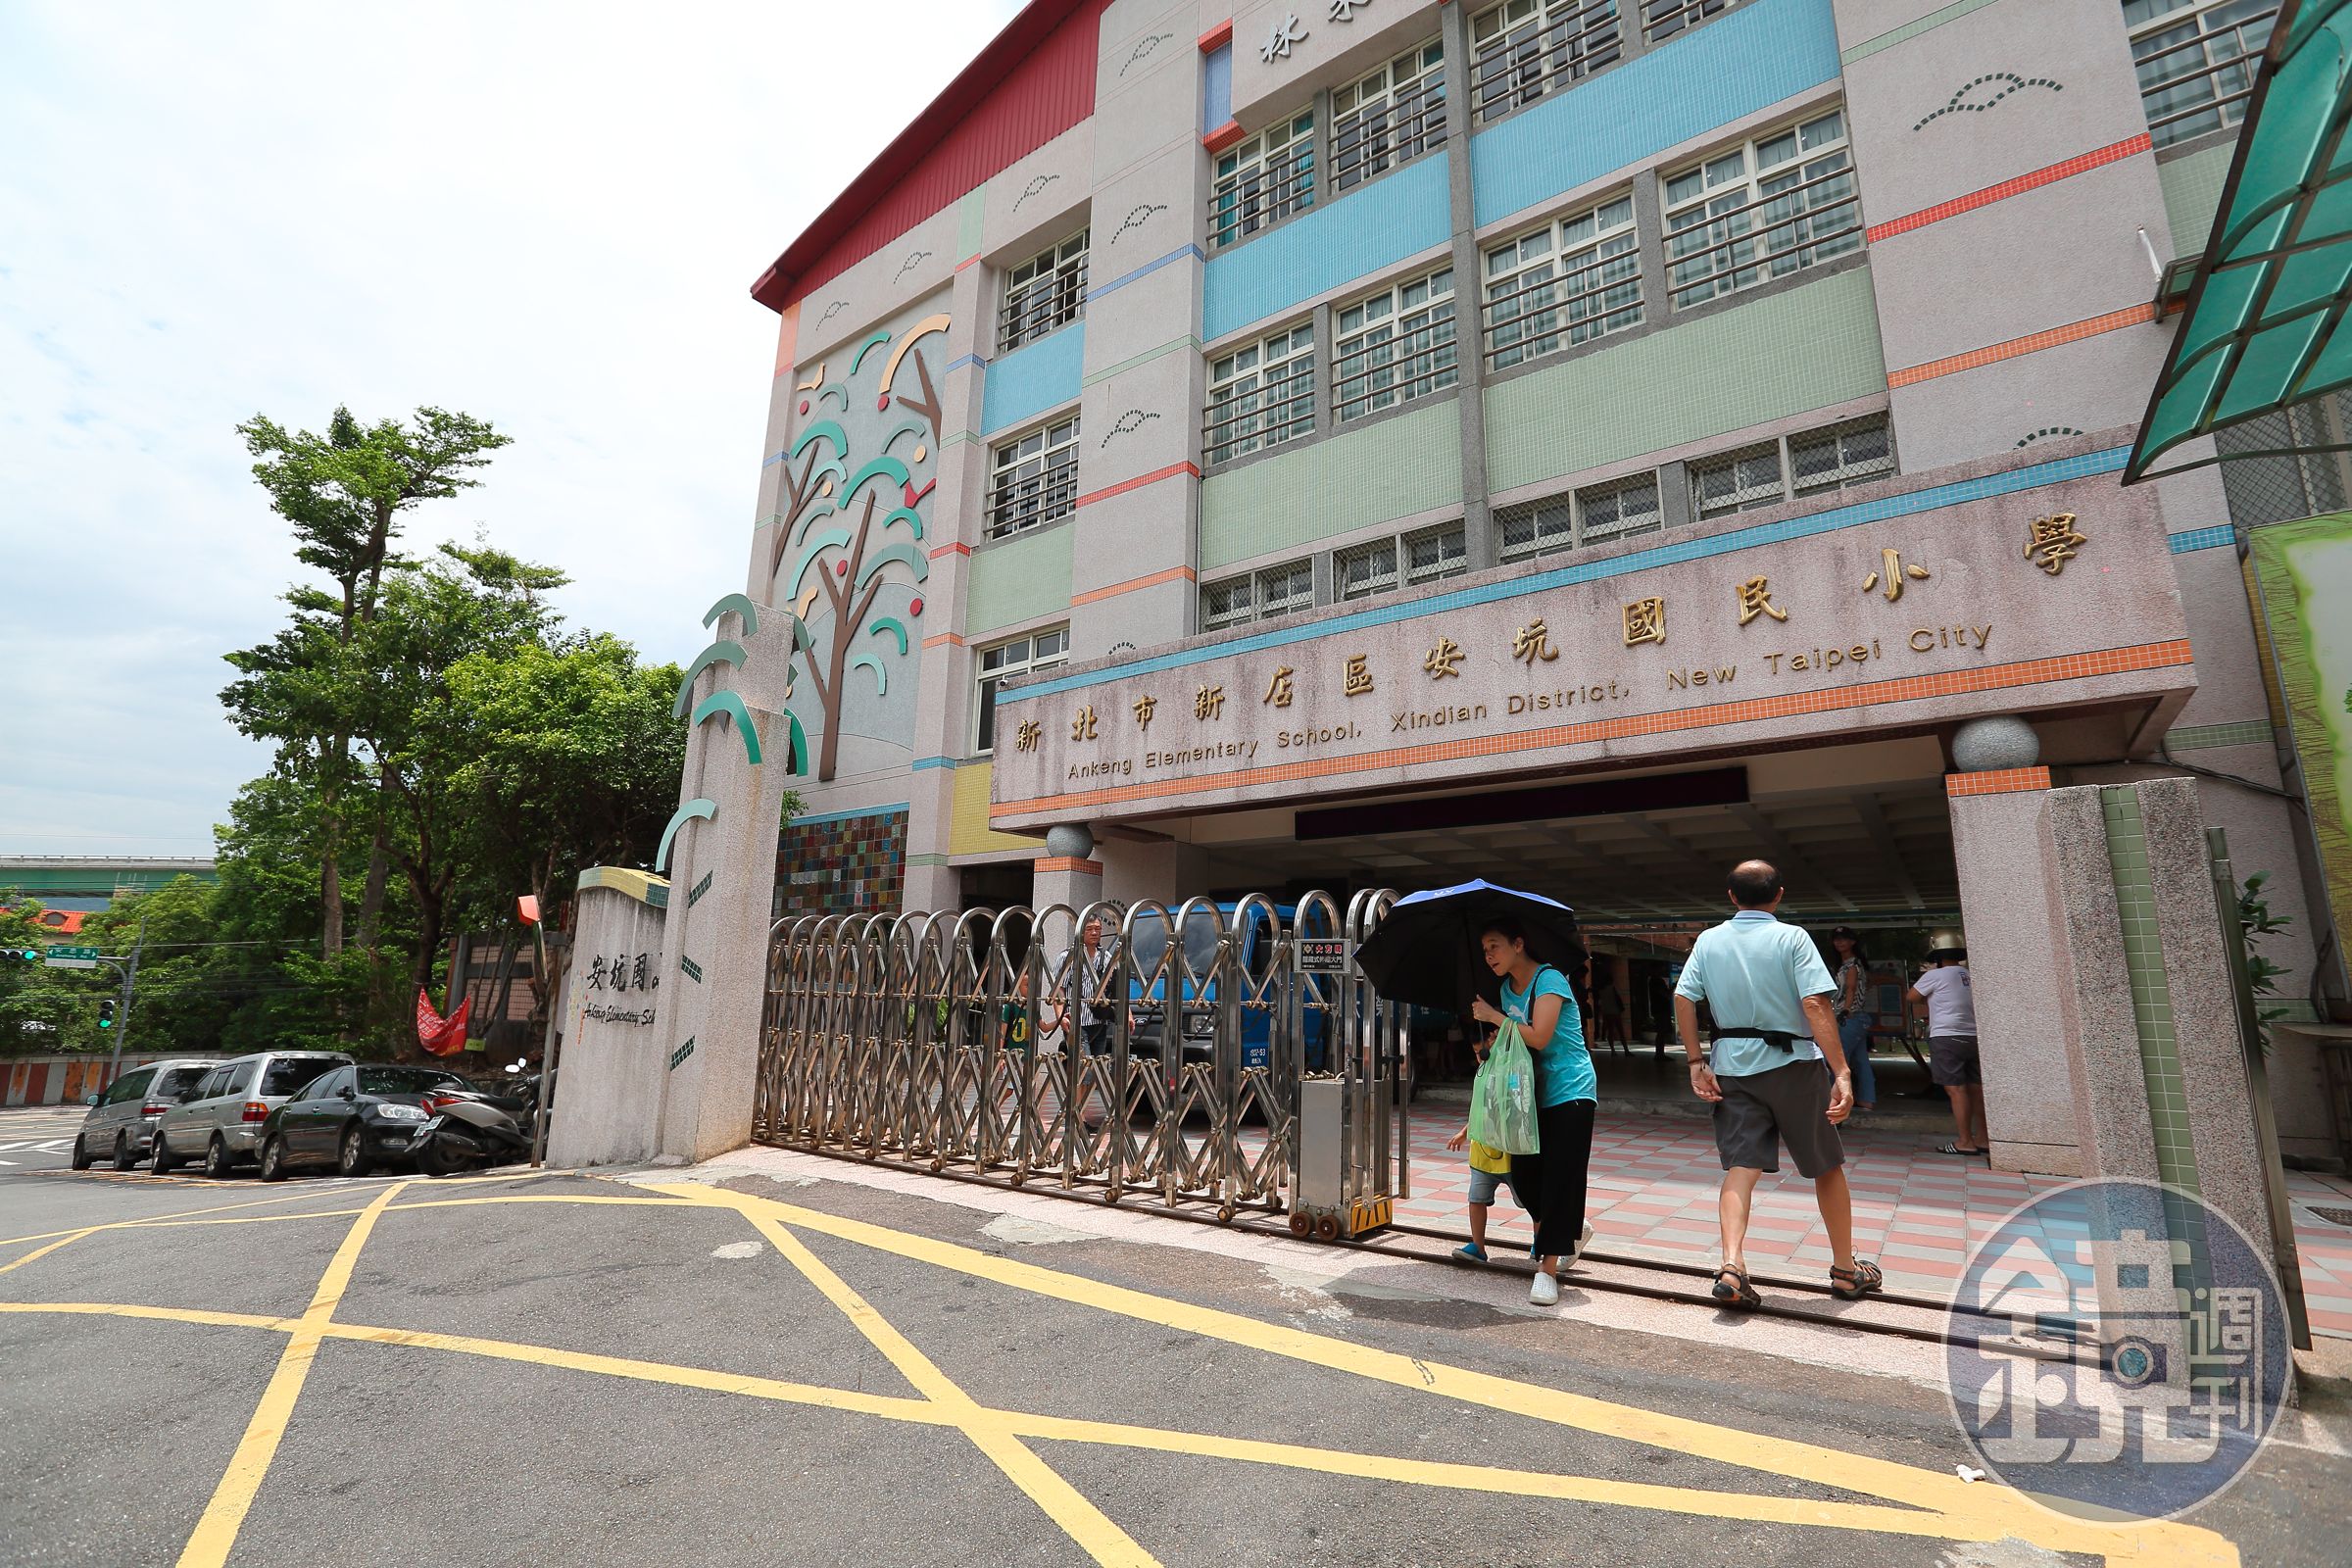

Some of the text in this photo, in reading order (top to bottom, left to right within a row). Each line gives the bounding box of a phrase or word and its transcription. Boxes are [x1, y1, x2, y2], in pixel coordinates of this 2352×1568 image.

[1015, 513, 2087, 752] 新北市新店區安坑國民小學
[1068, 623, 1992, 779] Ankeng Elementary School, Xindian District, New Taipei City
[587, 953, 663, 992] 安坑國
